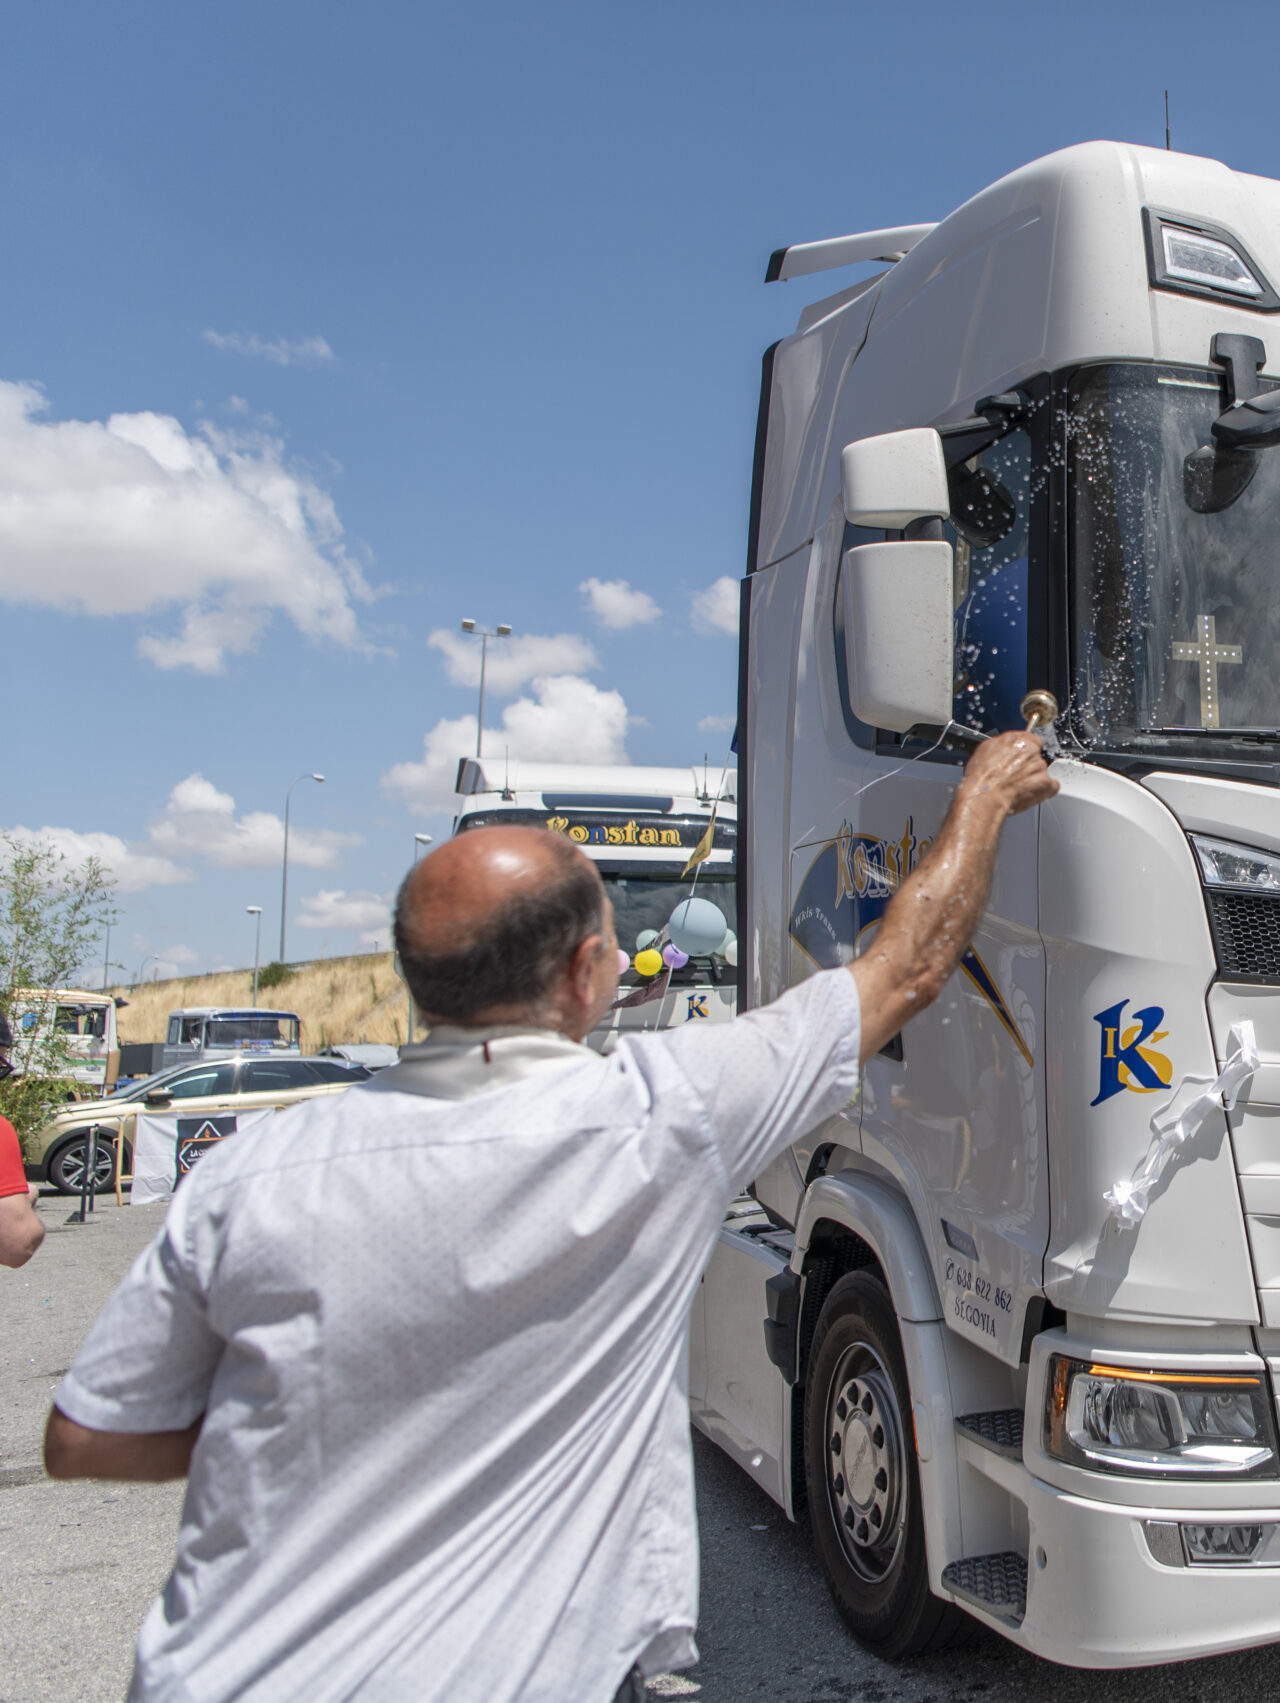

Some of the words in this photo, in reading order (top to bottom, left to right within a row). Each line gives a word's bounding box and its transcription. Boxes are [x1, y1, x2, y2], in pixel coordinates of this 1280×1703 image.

[957, 1267, 972, 1290] 638
[975, 1276, 991, 1302] 622
[994, 1287, 1012, 1313] 862
